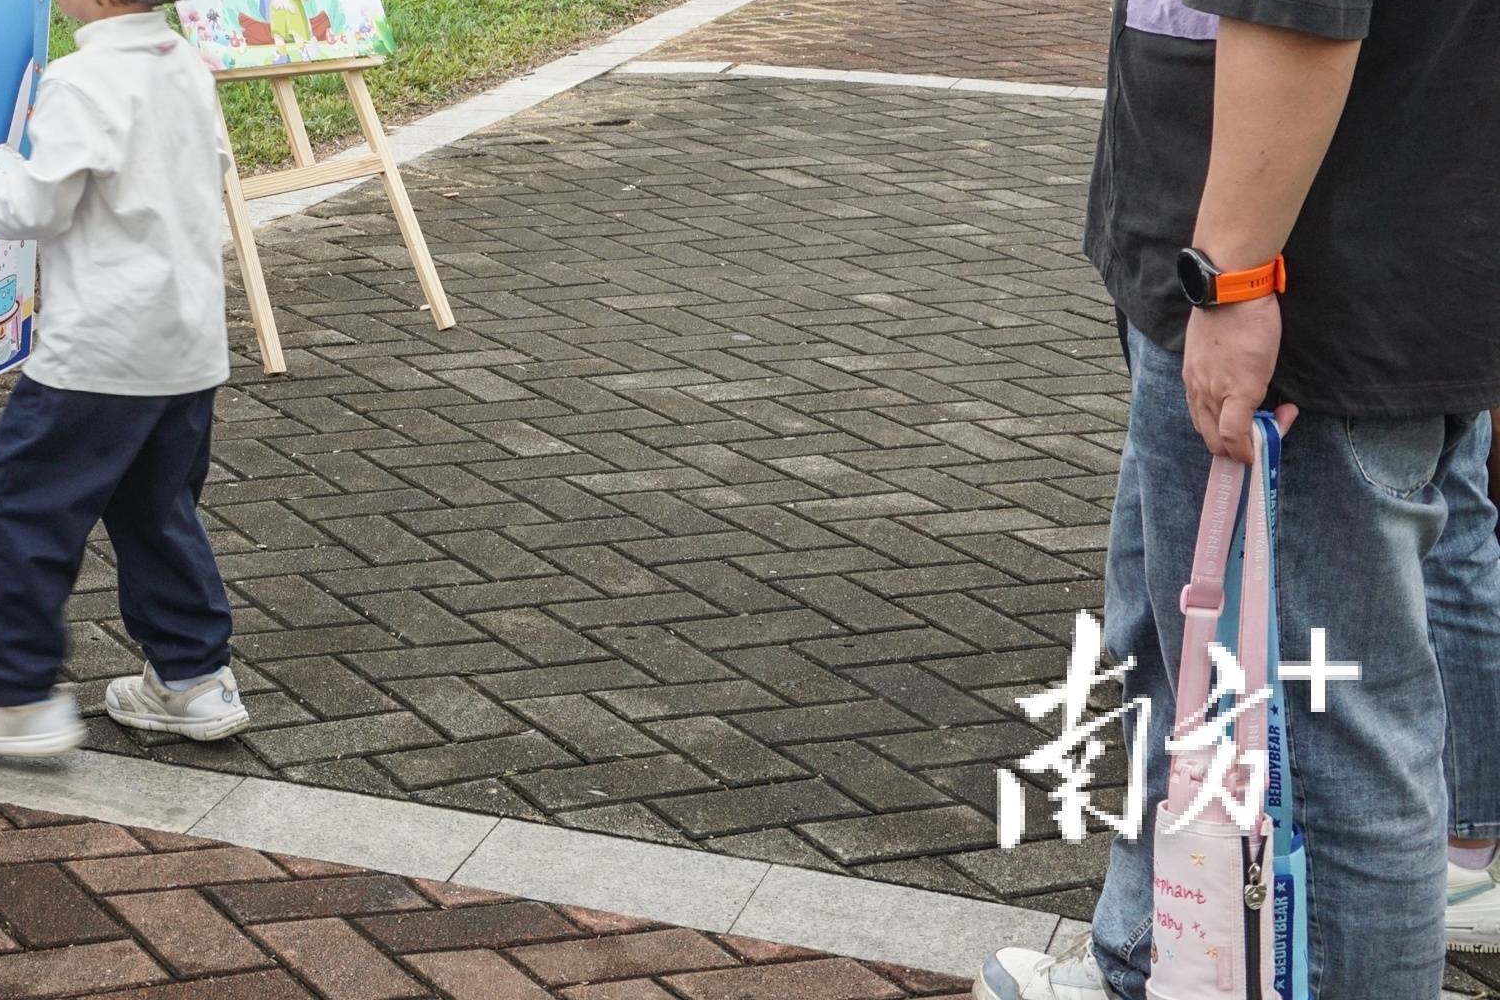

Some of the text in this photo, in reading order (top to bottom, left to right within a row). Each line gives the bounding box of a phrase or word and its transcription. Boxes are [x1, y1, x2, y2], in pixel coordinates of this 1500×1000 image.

[1268, 724, 1283, 808] BEDDYBEAR
[1156, 907, 1183, 940] baby
[1275, 896, 1288, 976] BEDDYBEAR
